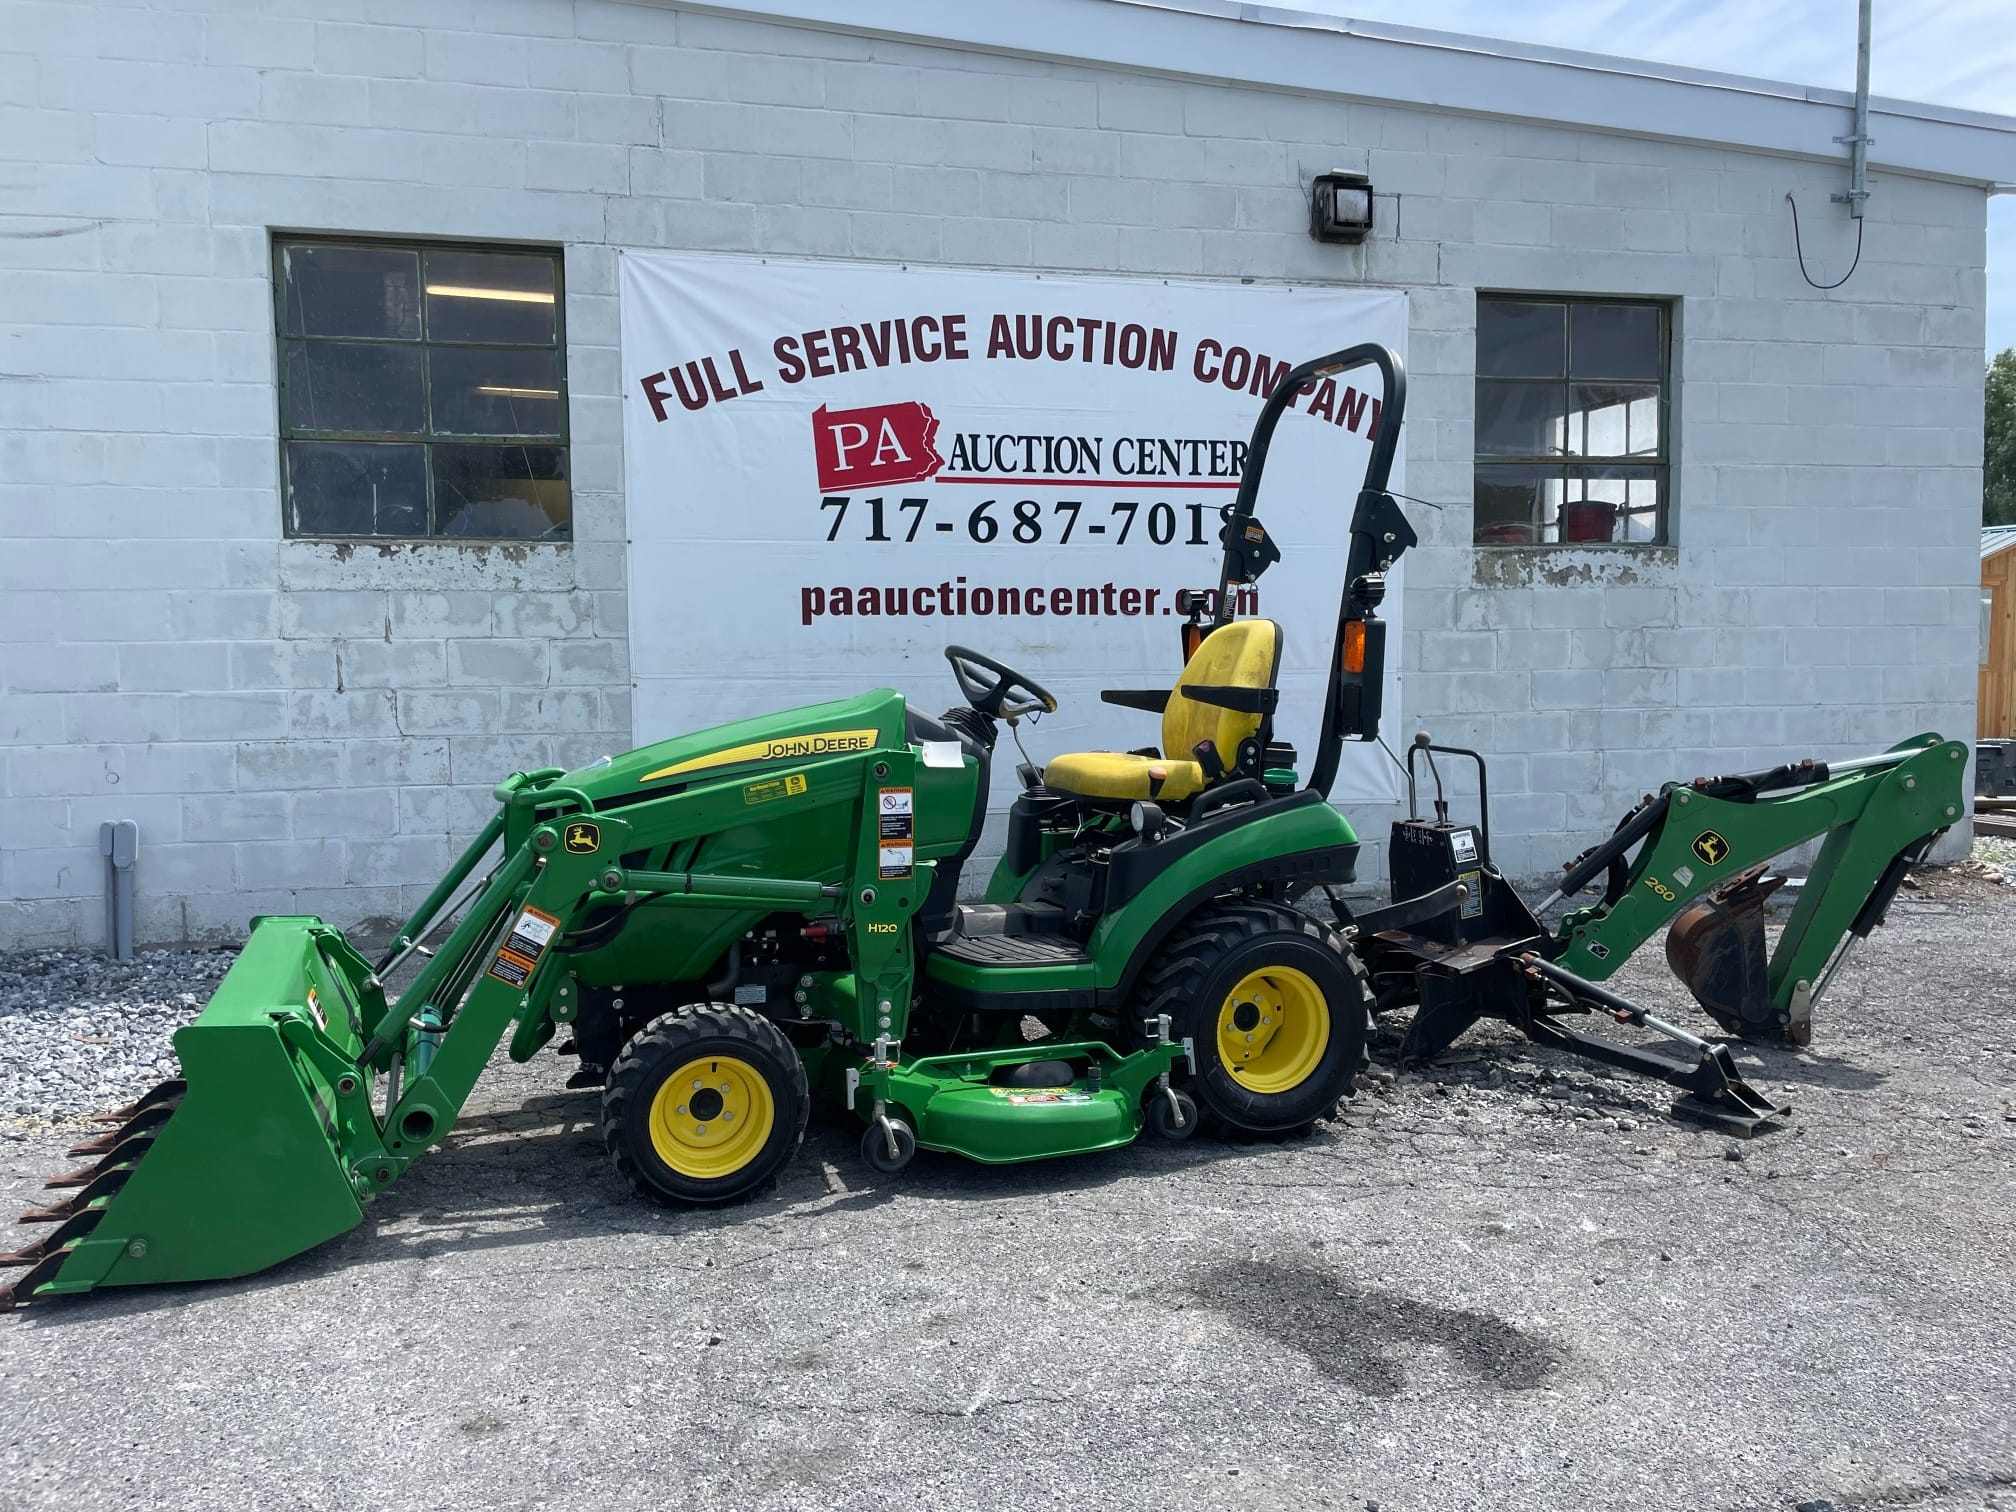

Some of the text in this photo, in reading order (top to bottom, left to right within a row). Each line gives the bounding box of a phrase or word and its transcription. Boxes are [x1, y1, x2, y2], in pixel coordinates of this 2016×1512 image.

[641, 349, 764, 423] FULL
[773, 314, 969, 384] SERVICE
[987, 314, 1178, 371] AUCTION
[828, 417, 911, 472] PA
[948, 433, 1249, 477] AUCTION CENTER
[762, 737, 869, 758] JOHN DEERE
[1644, 877, 1676, 901] 260
[868, 923, 898, 933] H120
